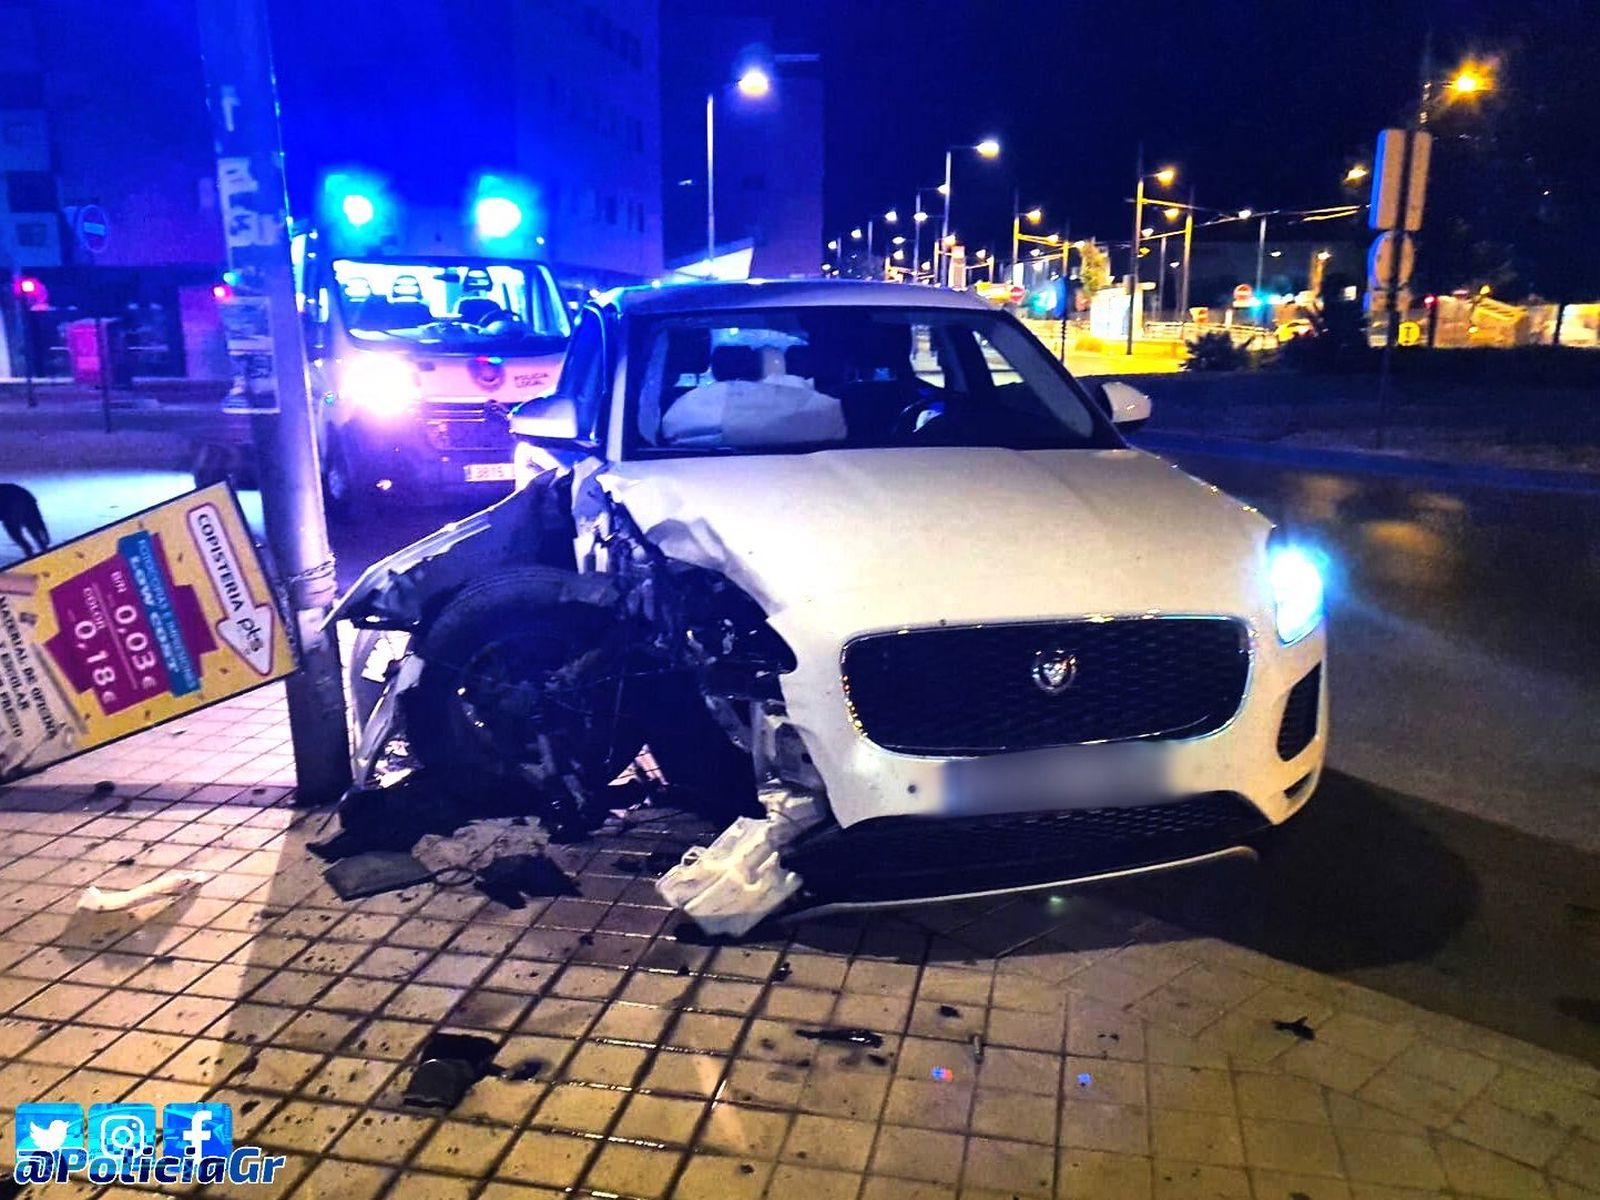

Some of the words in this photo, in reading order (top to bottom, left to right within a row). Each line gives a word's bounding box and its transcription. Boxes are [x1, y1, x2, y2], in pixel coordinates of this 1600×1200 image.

[83, 587, 106, 630] COLOR
[130, 555, 155, 606] LOW
[149, 611, 179, 673] COST
[198, 513, 244, 612] COPISTERIA
[236, 617, 264, 652] pts
[75, 620, 116, 685] 0,18
[115, 604, 156, 671] 0,03
